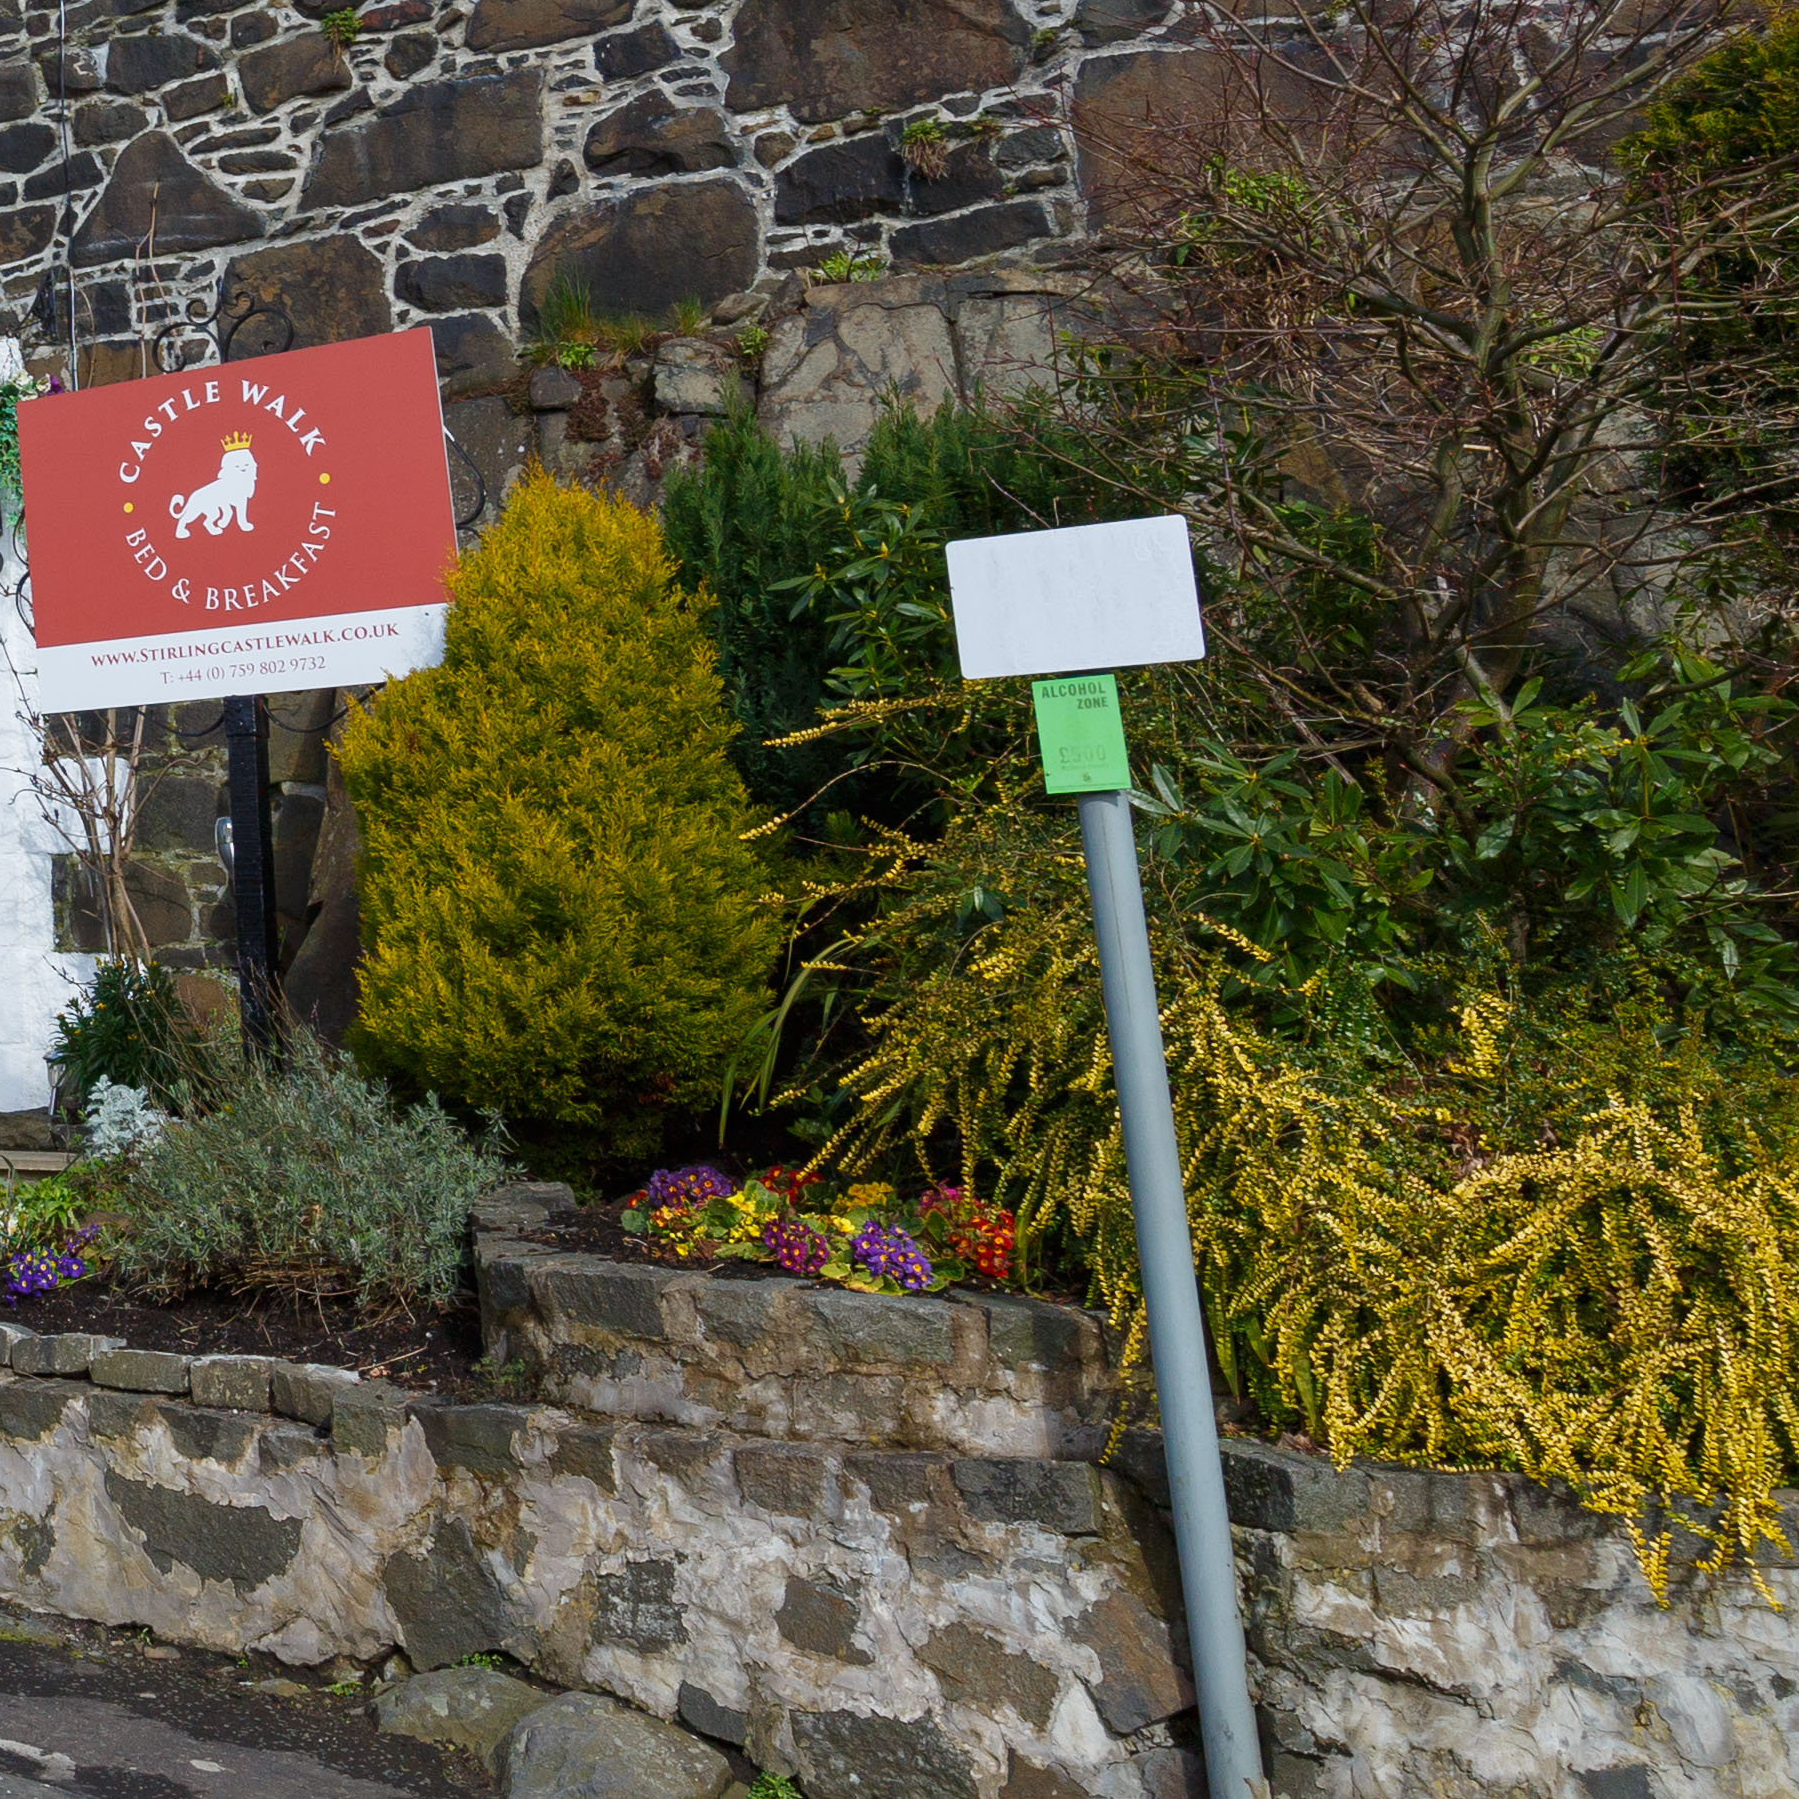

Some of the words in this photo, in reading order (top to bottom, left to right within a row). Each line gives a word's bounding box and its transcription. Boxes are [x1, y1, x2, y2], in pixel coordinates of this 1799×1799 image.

[119, 380, 221, 484] CASTLE
[241, 379, 327, 457] WALK
[125, 527, 168, 582] BED
[171, 577, 191, 605] &
[204, 501, 336, 612] BREAKFAST
[160, 671, 174, 685] T:
[178, 668, 202, 682] +44
[206, 665, 226, 682] (0)
[229, 662, 255, 679] 759
[259, 659, 286, 675] 802
[290, 656, 327, 671] 9732
[1042, 682, 1105, 698] ALCOHOL
[1077, 697, 1108, 709] ZONE
